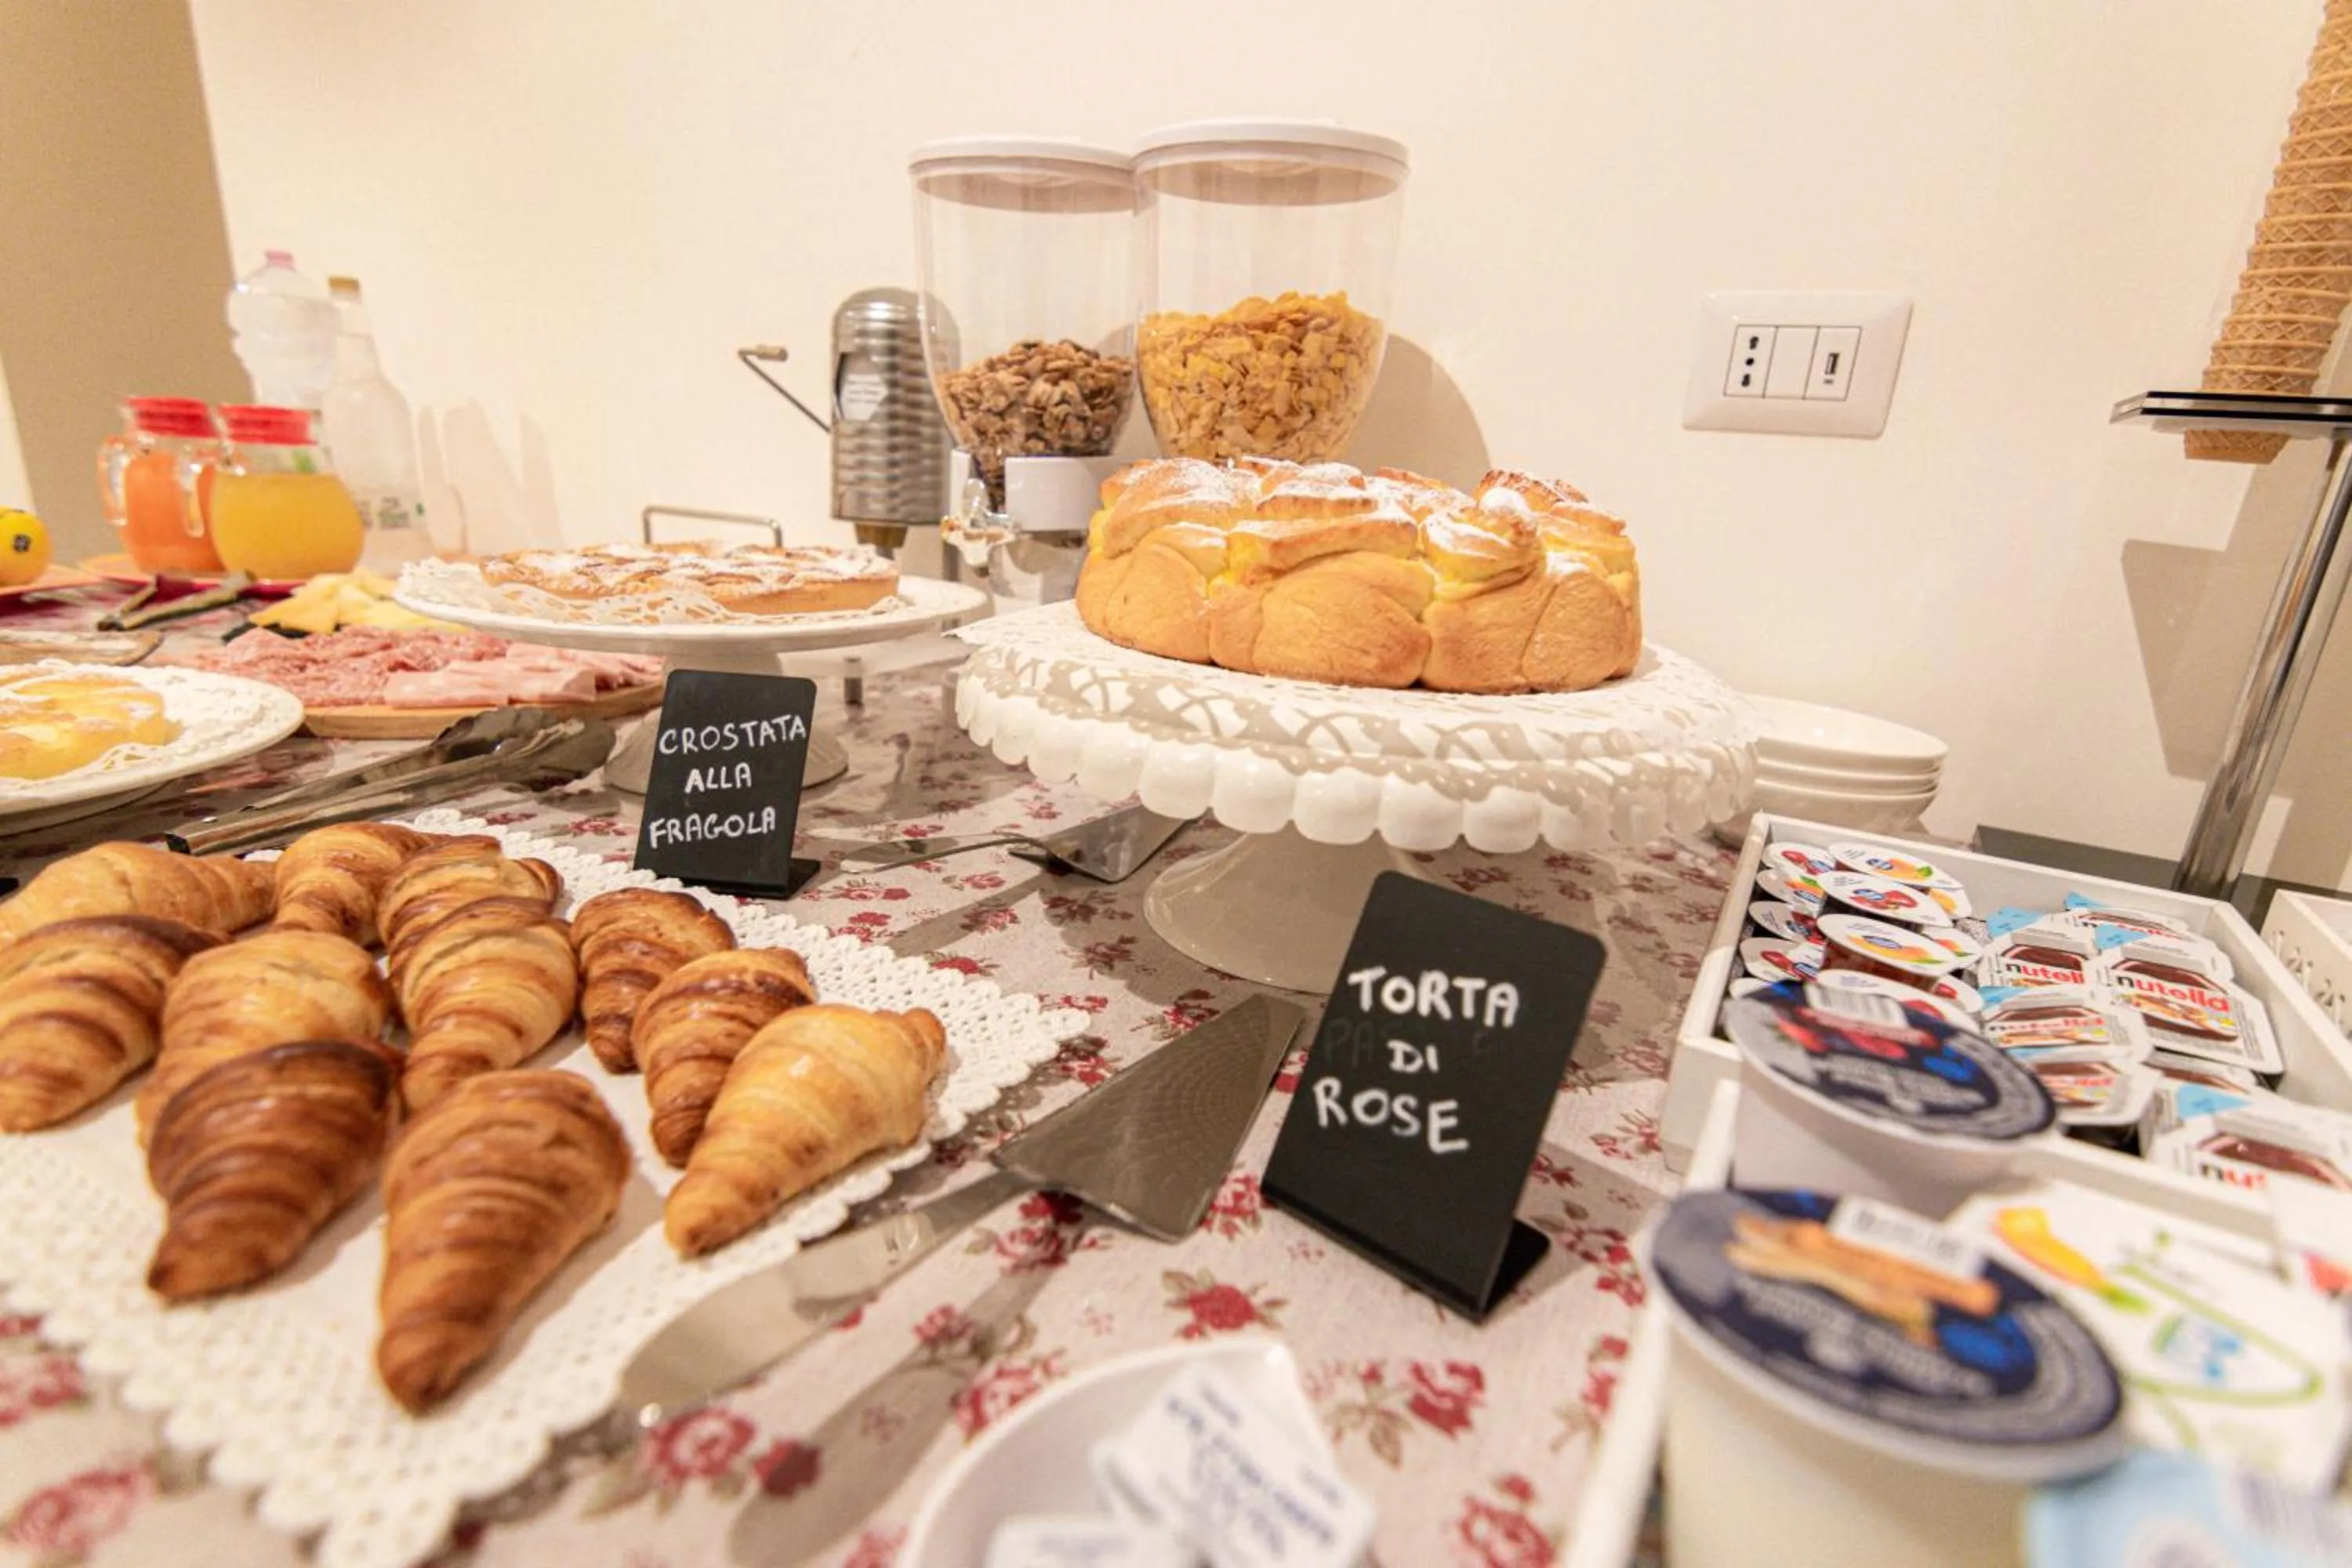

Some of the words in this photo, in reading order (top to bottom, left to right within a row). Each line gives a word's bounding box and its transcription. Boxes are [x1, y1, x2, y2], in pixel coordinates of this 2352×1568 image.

[659, 715, 806, 754] CROSTATA
[684, 762, 752, 793] ALLA
[649, 806, 775, 849] FRAGOLA
[2005, 964, 2085, 984] nutell
[1347, 965, 1519, 1027] TORTA
[2117, 976, 2230, 1013] nutella
[1387, 1040, 1439, 1073] DI
[1312, 1076, 1469, 1155] ROSE
